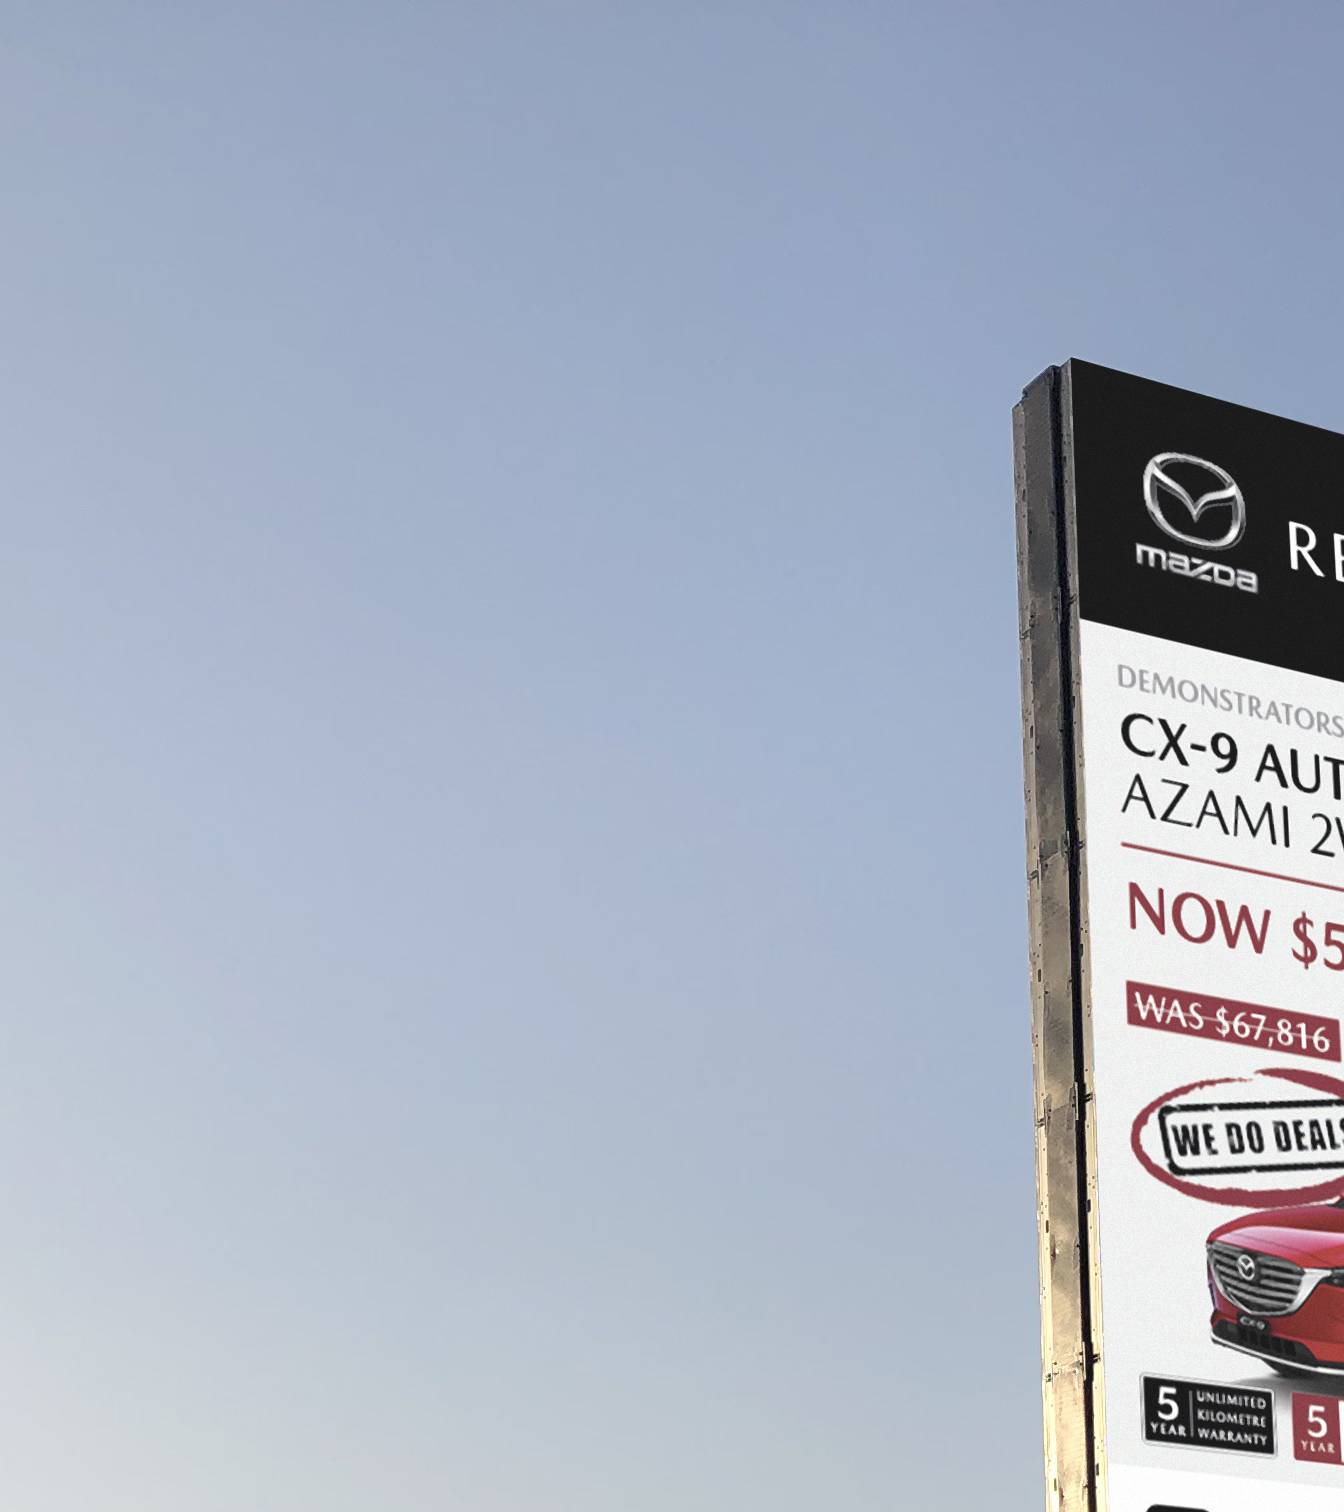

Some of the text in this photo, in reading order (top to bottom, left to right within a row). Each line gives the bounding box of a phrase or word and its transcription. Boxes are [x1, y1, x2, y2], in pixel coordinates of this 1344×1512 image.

[1136, 543, 1259, 594] mazda
[1117, 665, 1344, 738] DEMONSTRATORS
[1120, 713, 1238, 774] CX-9
[1121, 773, 1290, 848] AZAMI
[1129, 882, 1272, 954] NOW
[1135, 991, 1331, 1052] WAS $67,816
[1171, 1123, 1218, 1157] WE
[1225, 1121, 1265, 1154] DO
[1157, 1386, 1180, 1421] 5
[1196, 1390, 1267, 1410] UNLIMITED
[1150, 1422, 1187, 1438] YEAR
[1197, 1408, 1267, 1428] KILOMETRE
[1307, 1404, 1329, 1438] 5
[1197, 1428, 1268, 1446] WARRANTY
[1301, 1440, 1336, 1455] YEAR
